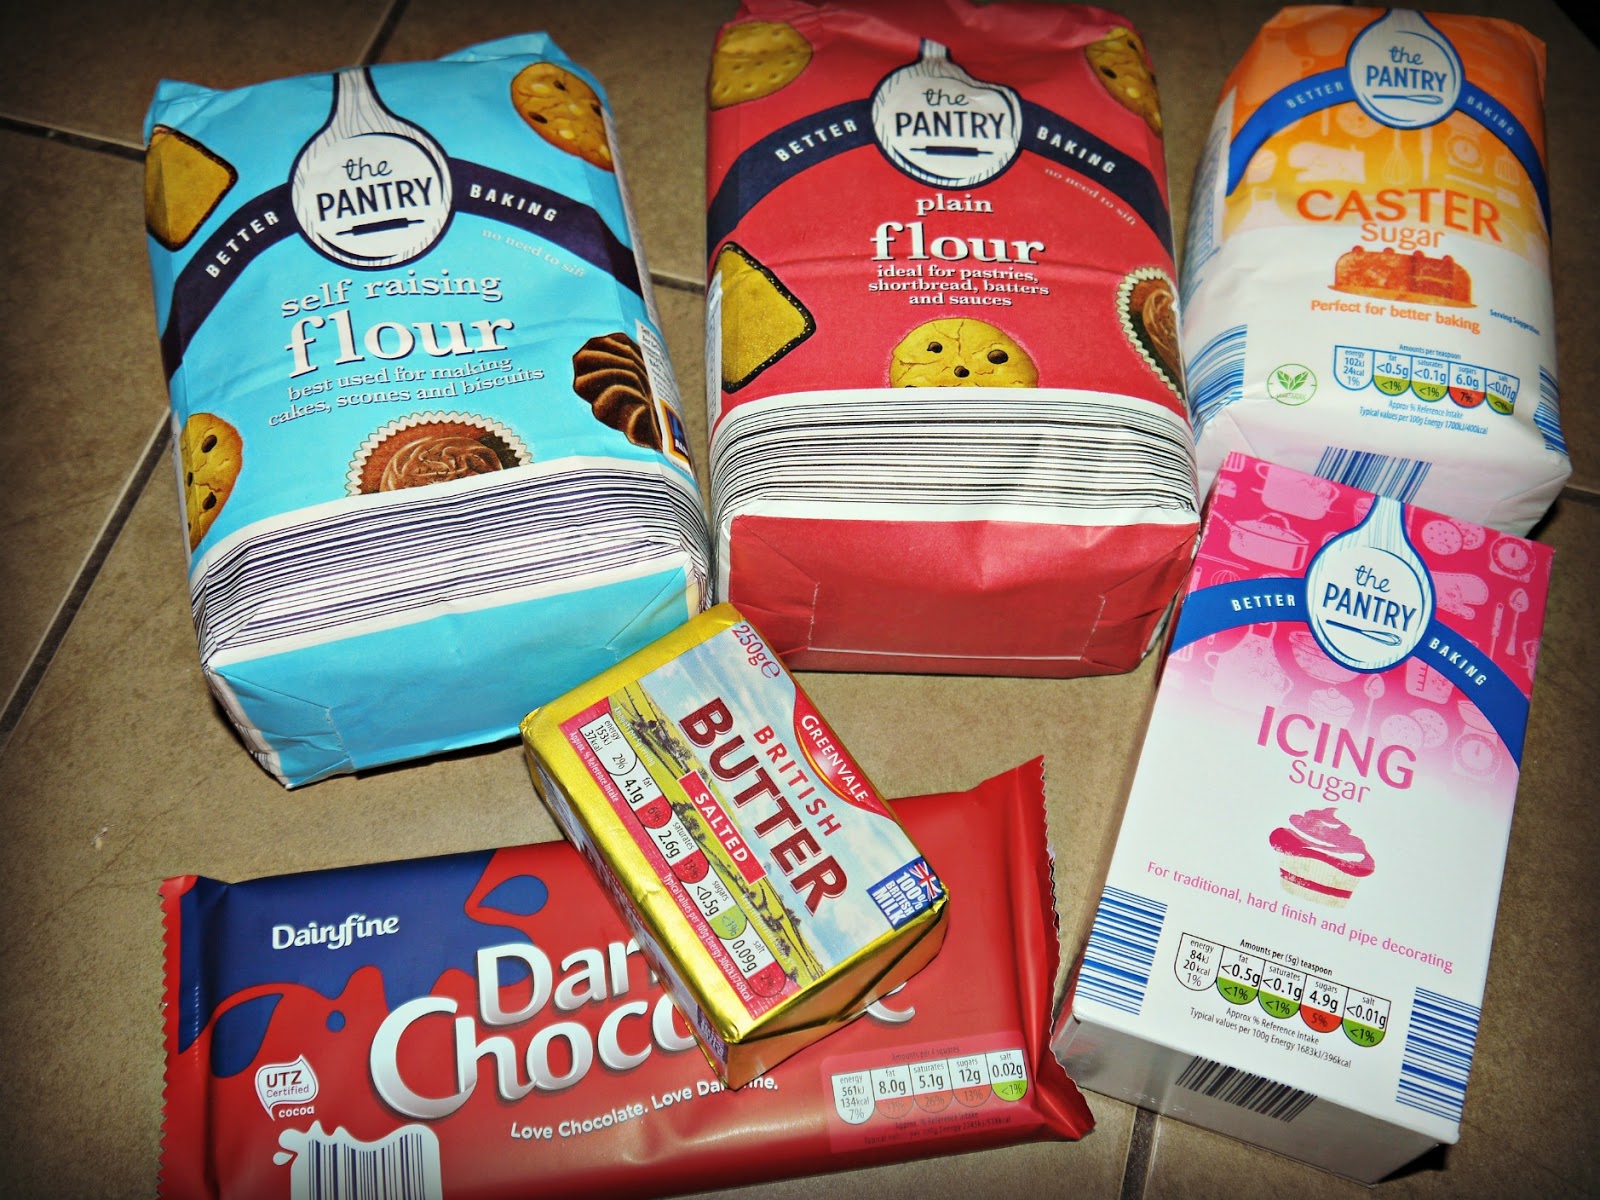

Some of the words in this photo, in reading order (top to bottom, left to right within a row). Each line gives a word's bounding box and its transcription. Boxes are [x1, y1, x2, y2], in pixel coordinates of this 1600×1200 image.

[1389, 46, 1424, 66] the
[1366, 65, 1448, 93] PANTRY
[922, 88, 969, 106] the
[1286, 81, 1344, 110] BETTER
[1467, 96, 1515, 136] BAKING
[895, 111, 1005, 139] PANTRY
[774, 119, 858, 162] BETTER
[1036, 126, 1116, 174] BAKING
[342, 157, 392, 181] the
[316, 177, 432, 222] PANTRY
[1044, 168, 1062, 180] no
[1065, 177, 1099, 198] need
[1100, 196, 1114, 208] to
[915, 193, 993, 216] plain
[1296, 188, 1503, 243] CASTER
[205, 211, 280, 278] BETTER
[470, 184, 557, 222] BAKING
[870, 221, 1045, 264] flour
[1361, 221, 1445, 250] Sugar
[481, 229, 502, 241] no
[505, 237, 542, 257] need
[544, 254, 559, 267] to
[877, 264, 923, 278] ideal
[928, 264, 956, 278] for
[960, 267, 1039, 284] pastries,
[281, 279, 353, 318] self
[364, 269, 503, 302] raising
[868, 279, 979, 294] shortbread,
[983, 280, 1050, 295] batters
[909, 292, 945, 306] and
[949, 294, 1013, 306] sauces
[1311, 299, 1361, 314] Perfect
[1365, 302, 1386, 316] for
[1390, 305, 1432, 322] better
[1435, 311, 1481, 335] baking
[284, 308, 514, 379] flour
[1345, 350, 1365, 358] energy
[287, 378, 333, 402] best
[336, 368, 390, 388] used
[395, 367, 426, 382] for
[430, 356, 513, 381] making
[1348, 376, 1360, 386] 1%
[1376, 362, 1409, 379] <0.5g
[1414, 368, 1447, 385] <0.1g
[1456, 374, 1479, 390] 6.0g
[1458, 366, 1477, 375] sugars
[268, 399, 332, 427] cakes,
[337, 387, 410, 408] scones
[416, 382, 458, 399] and
[461, 367, 545, 394] biscuits
[1381, 381, 1402, 391] <1%
[1419, 386, 1440, 397] <1%
[1460, 391, 1473, 403] 7%
[1487, 381, 1517, 403] <0.01g
[1355, 564, 1391, 593] the
[1321, 582, 1417, 632] PANTRY
[1231, 594, 1297, 612] BETTER
[1429, 637, 1488, 687] BAKING
[604, 720, 621, 741] energy
[801, 714, 869, 802] GREENVALE
[1256, 705, 1417, 790] ICING
[612, 753, 628, 769] 2%
[625, 779, 644, 804] 4.1g
[642, 777, 653, 788] fat
[753, 725, 842, 837] BRITISH
[1288, 759, 1371, 804] Sugar
[678, 696, 848, 917] BUTTER
[672, 822, 695, 850] saturates
[694, 792, 748, 863] SALTED
[658, 829, 681, 859] 2.6g
[696, 886, 719, 917] <0.5g
[712, 880, 730, 902] sugars
[885, 880, 915, 917] BRITISH
[896, 871, 929, 910] 100%
[871, 885, 907, 926] MILK
[1147, 861, 1170, 878] For
[1173, 870, 1242, 903] traditional,
[1247, 892, 1278, 913] hard
[1281, 903, 1317, 926] finish
[1320, 923, 1346, 935] and
[1348, 929, 1378, 946] pipe
[1382, 937, 1453, 975] decorating
[272, 912, 400, 950] Dairyfine
[732, 939, 757, 973] 0.09g
[753, 940, 765, 954] salt
[1190, 939, 1214, 954] energy
[1240, 938, 1271, 955] Amounts
[1272, 950, 1284, 961] per
[1285, 953, 1300, 966] (5g)
[1300, 959, 1333, 976] teaspoon
[1239, 954, 1249, 964] fat
[477, 937, 658, 1026] Dar
[1187, 972, 1202, 987] 1%
[1221, 963, 1260, 987] <0.5g
[1269, 965, 1301, 982] saturates
[1224, 986, 1248, 1001] <1%
[1262, 977, 1302, 1001] <0.1g
[1315, 981, 1338, 994] sugars
[1265, 1000, 1290, 1015] <1%
[1309, 990, 1339, 1014] 4.9g
[1362, 996, 1375, 1006] salt
[1225, 1007, 1251, 1023] Approx
[1261, 1018, 1295, 1037] Reference
[1297, 1031, 1320, 1045] Intake
[1312, 1012, 1328, 1028] 5%
[1346, 1004, 1387, 1029] <0.01g
[1190, 1006, 1214, 1024] Typical
[1215, 1014, 1237, 1031] values
[1238, 1025, 1250, 1036] per
[1252, 1027, 1270, 1043] 100g
[1270, 1034, 1296, 1051] Energy
[1350, 1028, 1375, 1043] <1%
[913, 1063, 944, 1073] saturates
[956, 1058, 978, 1068] sugars
[999, 1052, 1011, 1061] salt
[266, 1069, 302, 1089] UTZ
[840, 1074, 863, 1084] energy
[885, 1069, 896, 1077] fat
[919, 1073, 944, 1090] 5.1g
[959, 1069, 981, 1084] 12g
[992, 1062, 1023, 1078] 0.02g
[266, 1084, 310, 1098] Certified
[879, 1080, 907, 1096] 8.0g
[1001, 1083, 1023, 1096] <1%
[278, 1105, 315, 1118] cocoa
[511, 1122, 553, 1139] Love
[558, 1102, 649, 1138] Chocolate.
[650, 1086, 692, 1111] Love
[840, 1097, 869, 1108] 134kcal
[849, 1108, 864, 1120] 7%
